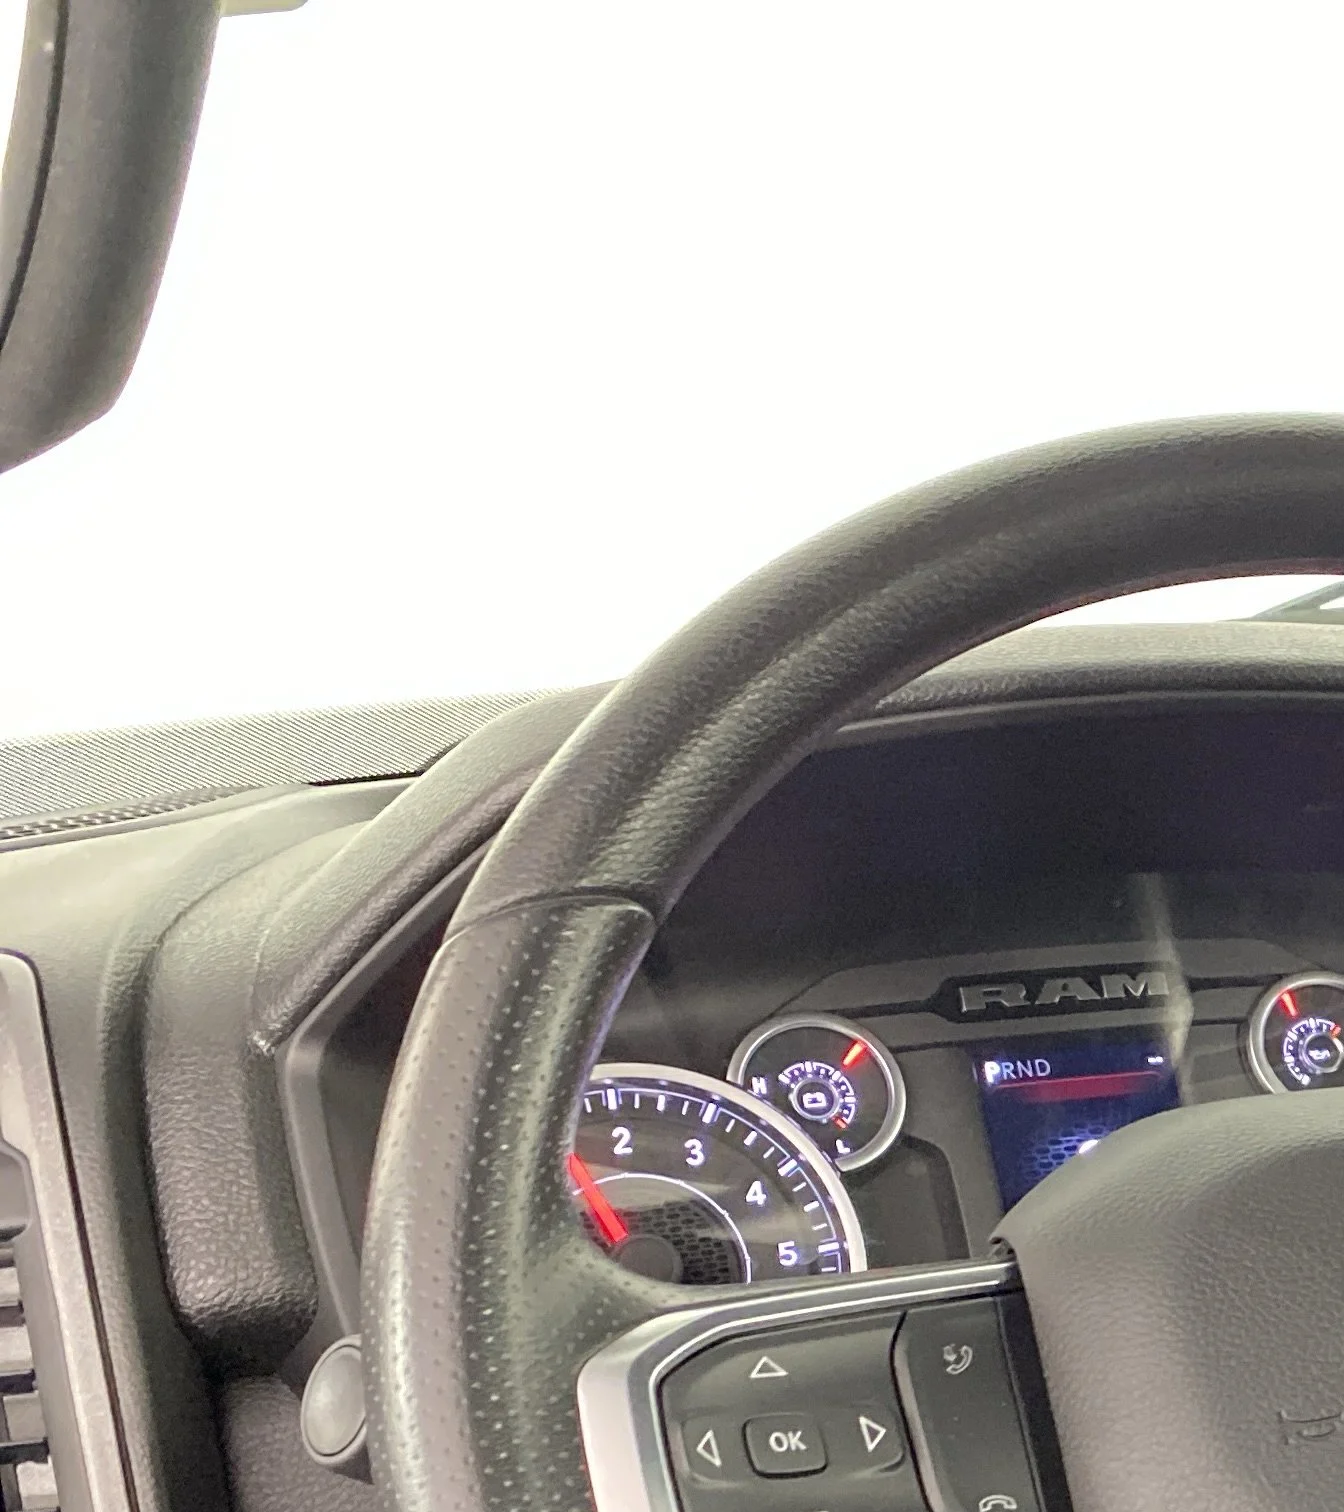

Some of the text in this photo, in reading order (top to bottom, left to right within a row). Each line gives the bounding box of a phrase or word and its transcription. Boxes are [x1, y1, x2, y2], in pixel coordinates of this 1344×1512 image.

[959, 971, 1170, 1013] RAM
[611, 1126, 633, 1155] 2
[684, 1138, 705, 1166] 3
[745, 1180, 767, 1206] 4
[777, 1240, 800, 1267] 5
[769, 1430, 807, 1452] OK
